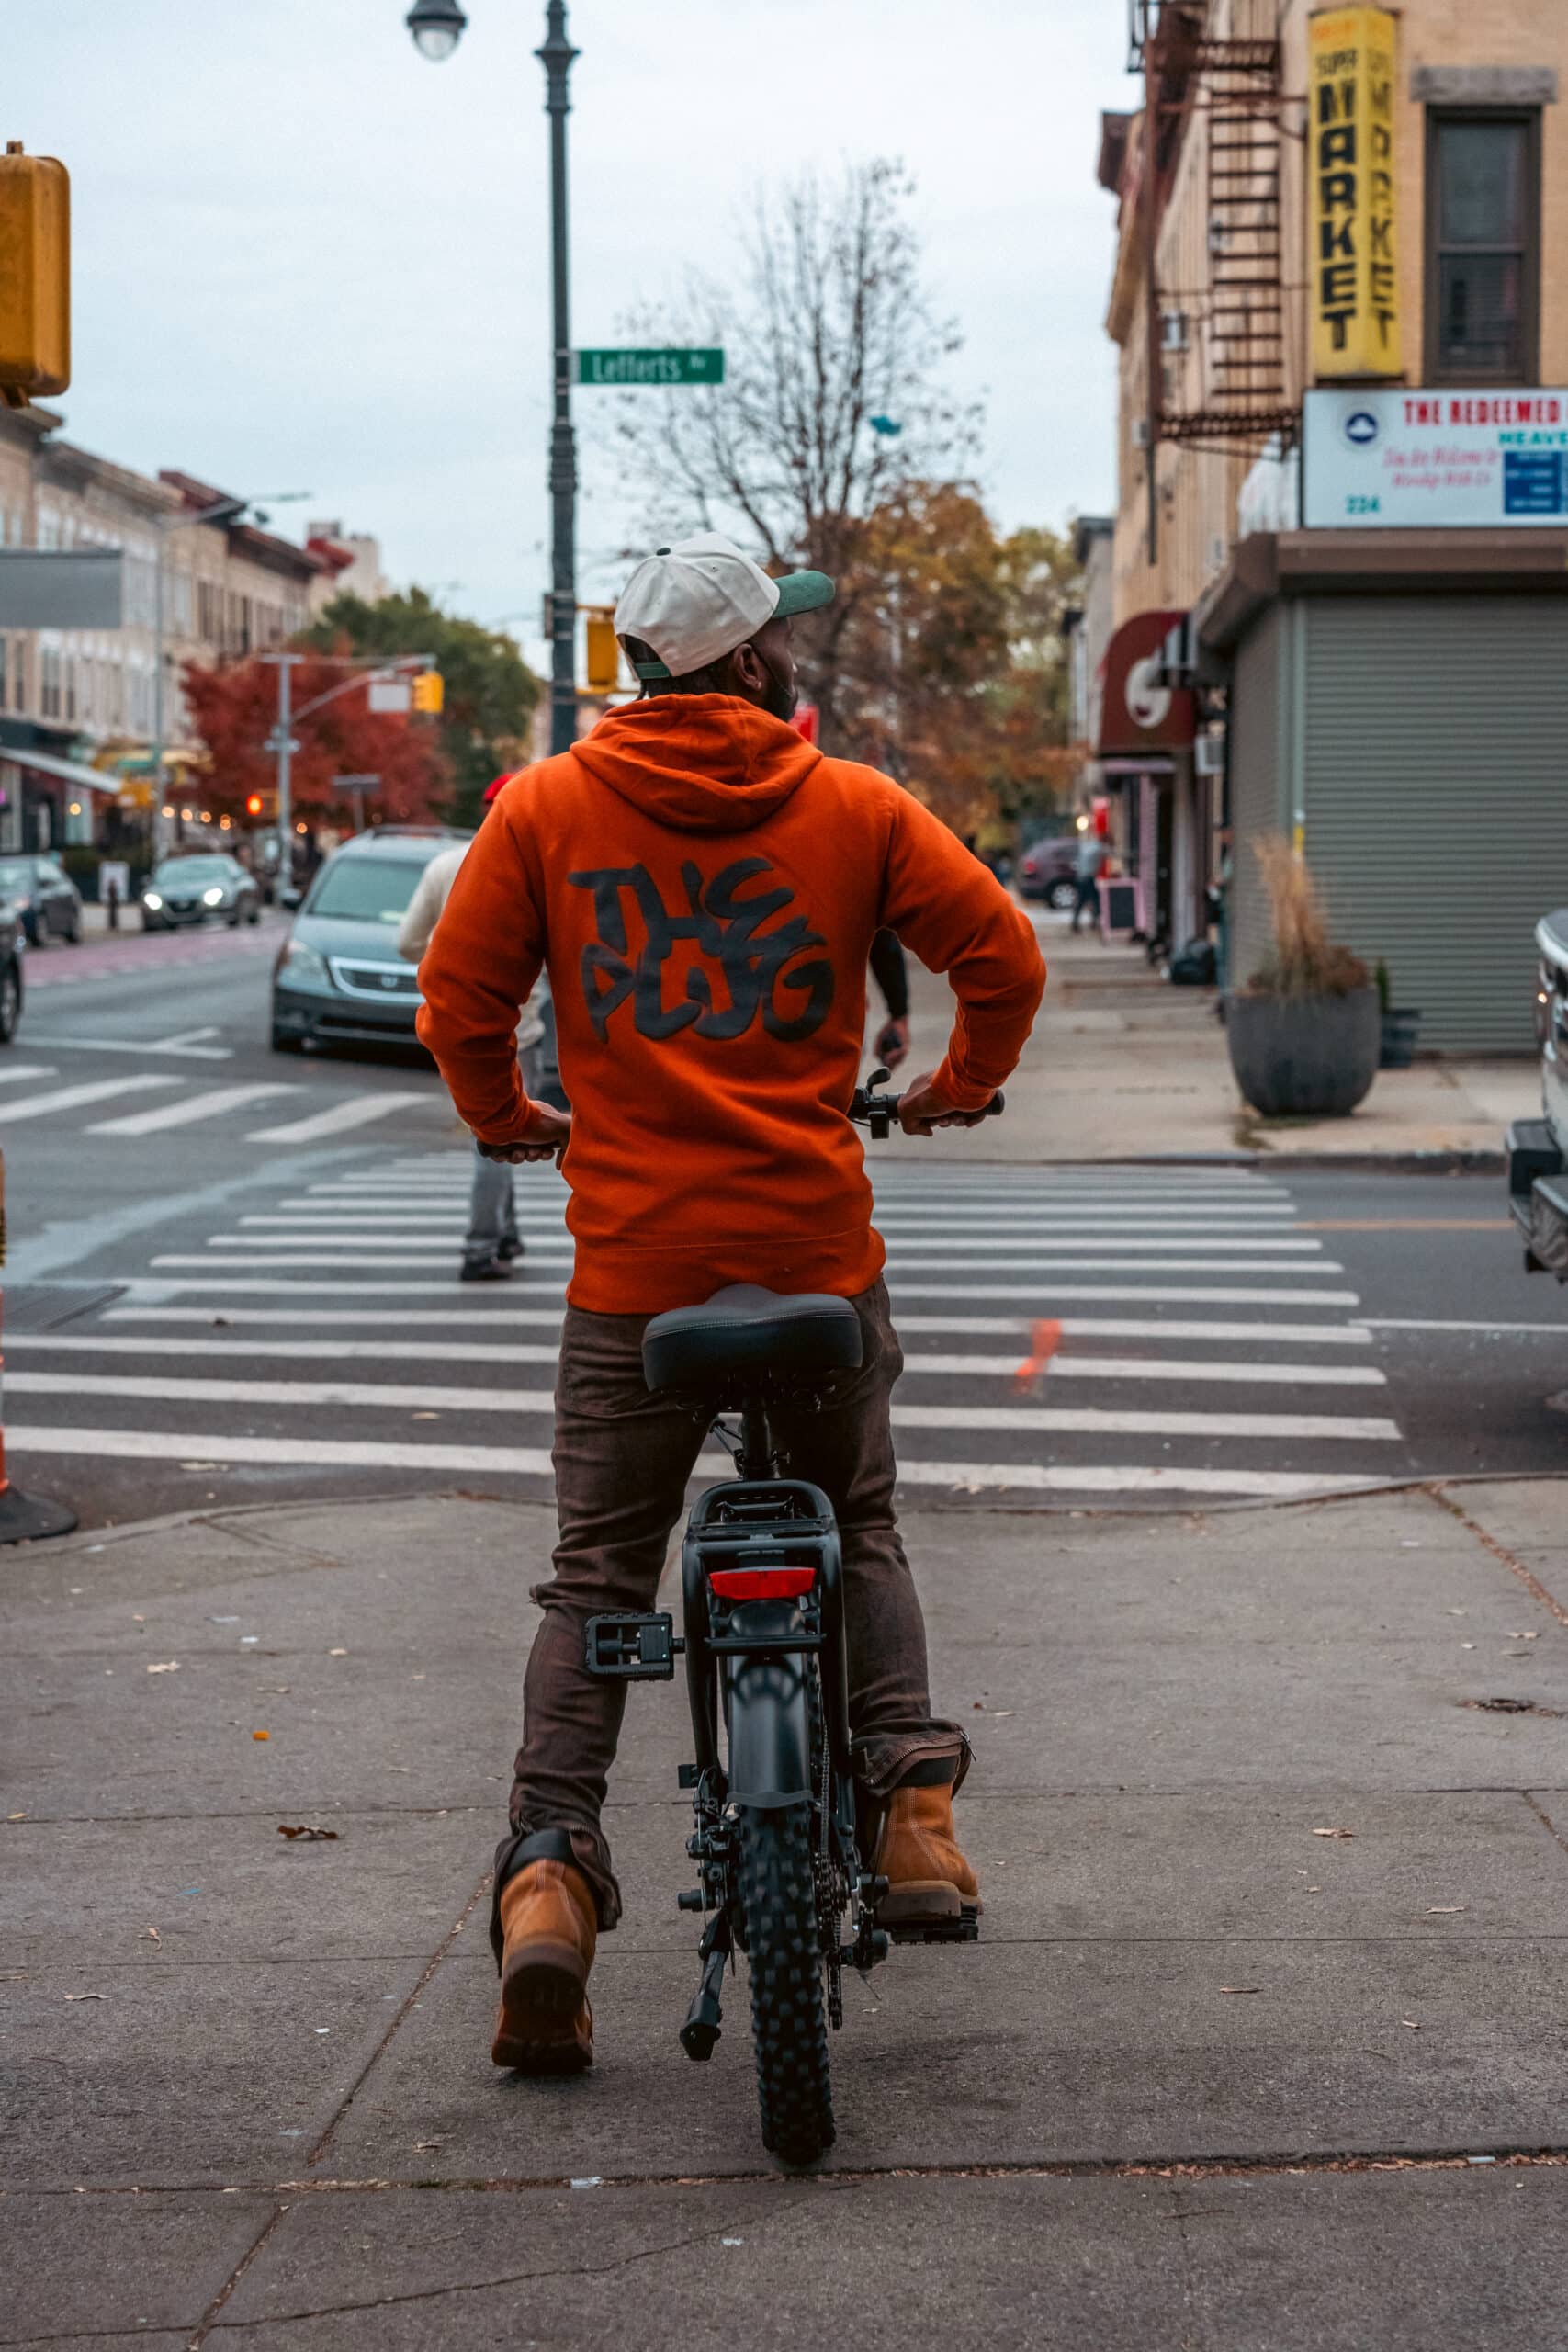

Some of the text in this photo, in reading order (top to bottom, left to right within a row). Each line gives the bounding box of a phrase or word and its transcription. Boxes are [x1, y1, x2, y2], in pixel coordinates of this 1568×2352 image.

[1316, 77, 1359, 351] MARKET
[592, 353, 682, 382] Lefferts
[1403, 398, 1561, 425] THE REDEEMED
[568, 857, 808, 956] THE
[580, 933, 835, 1044] PLUG
